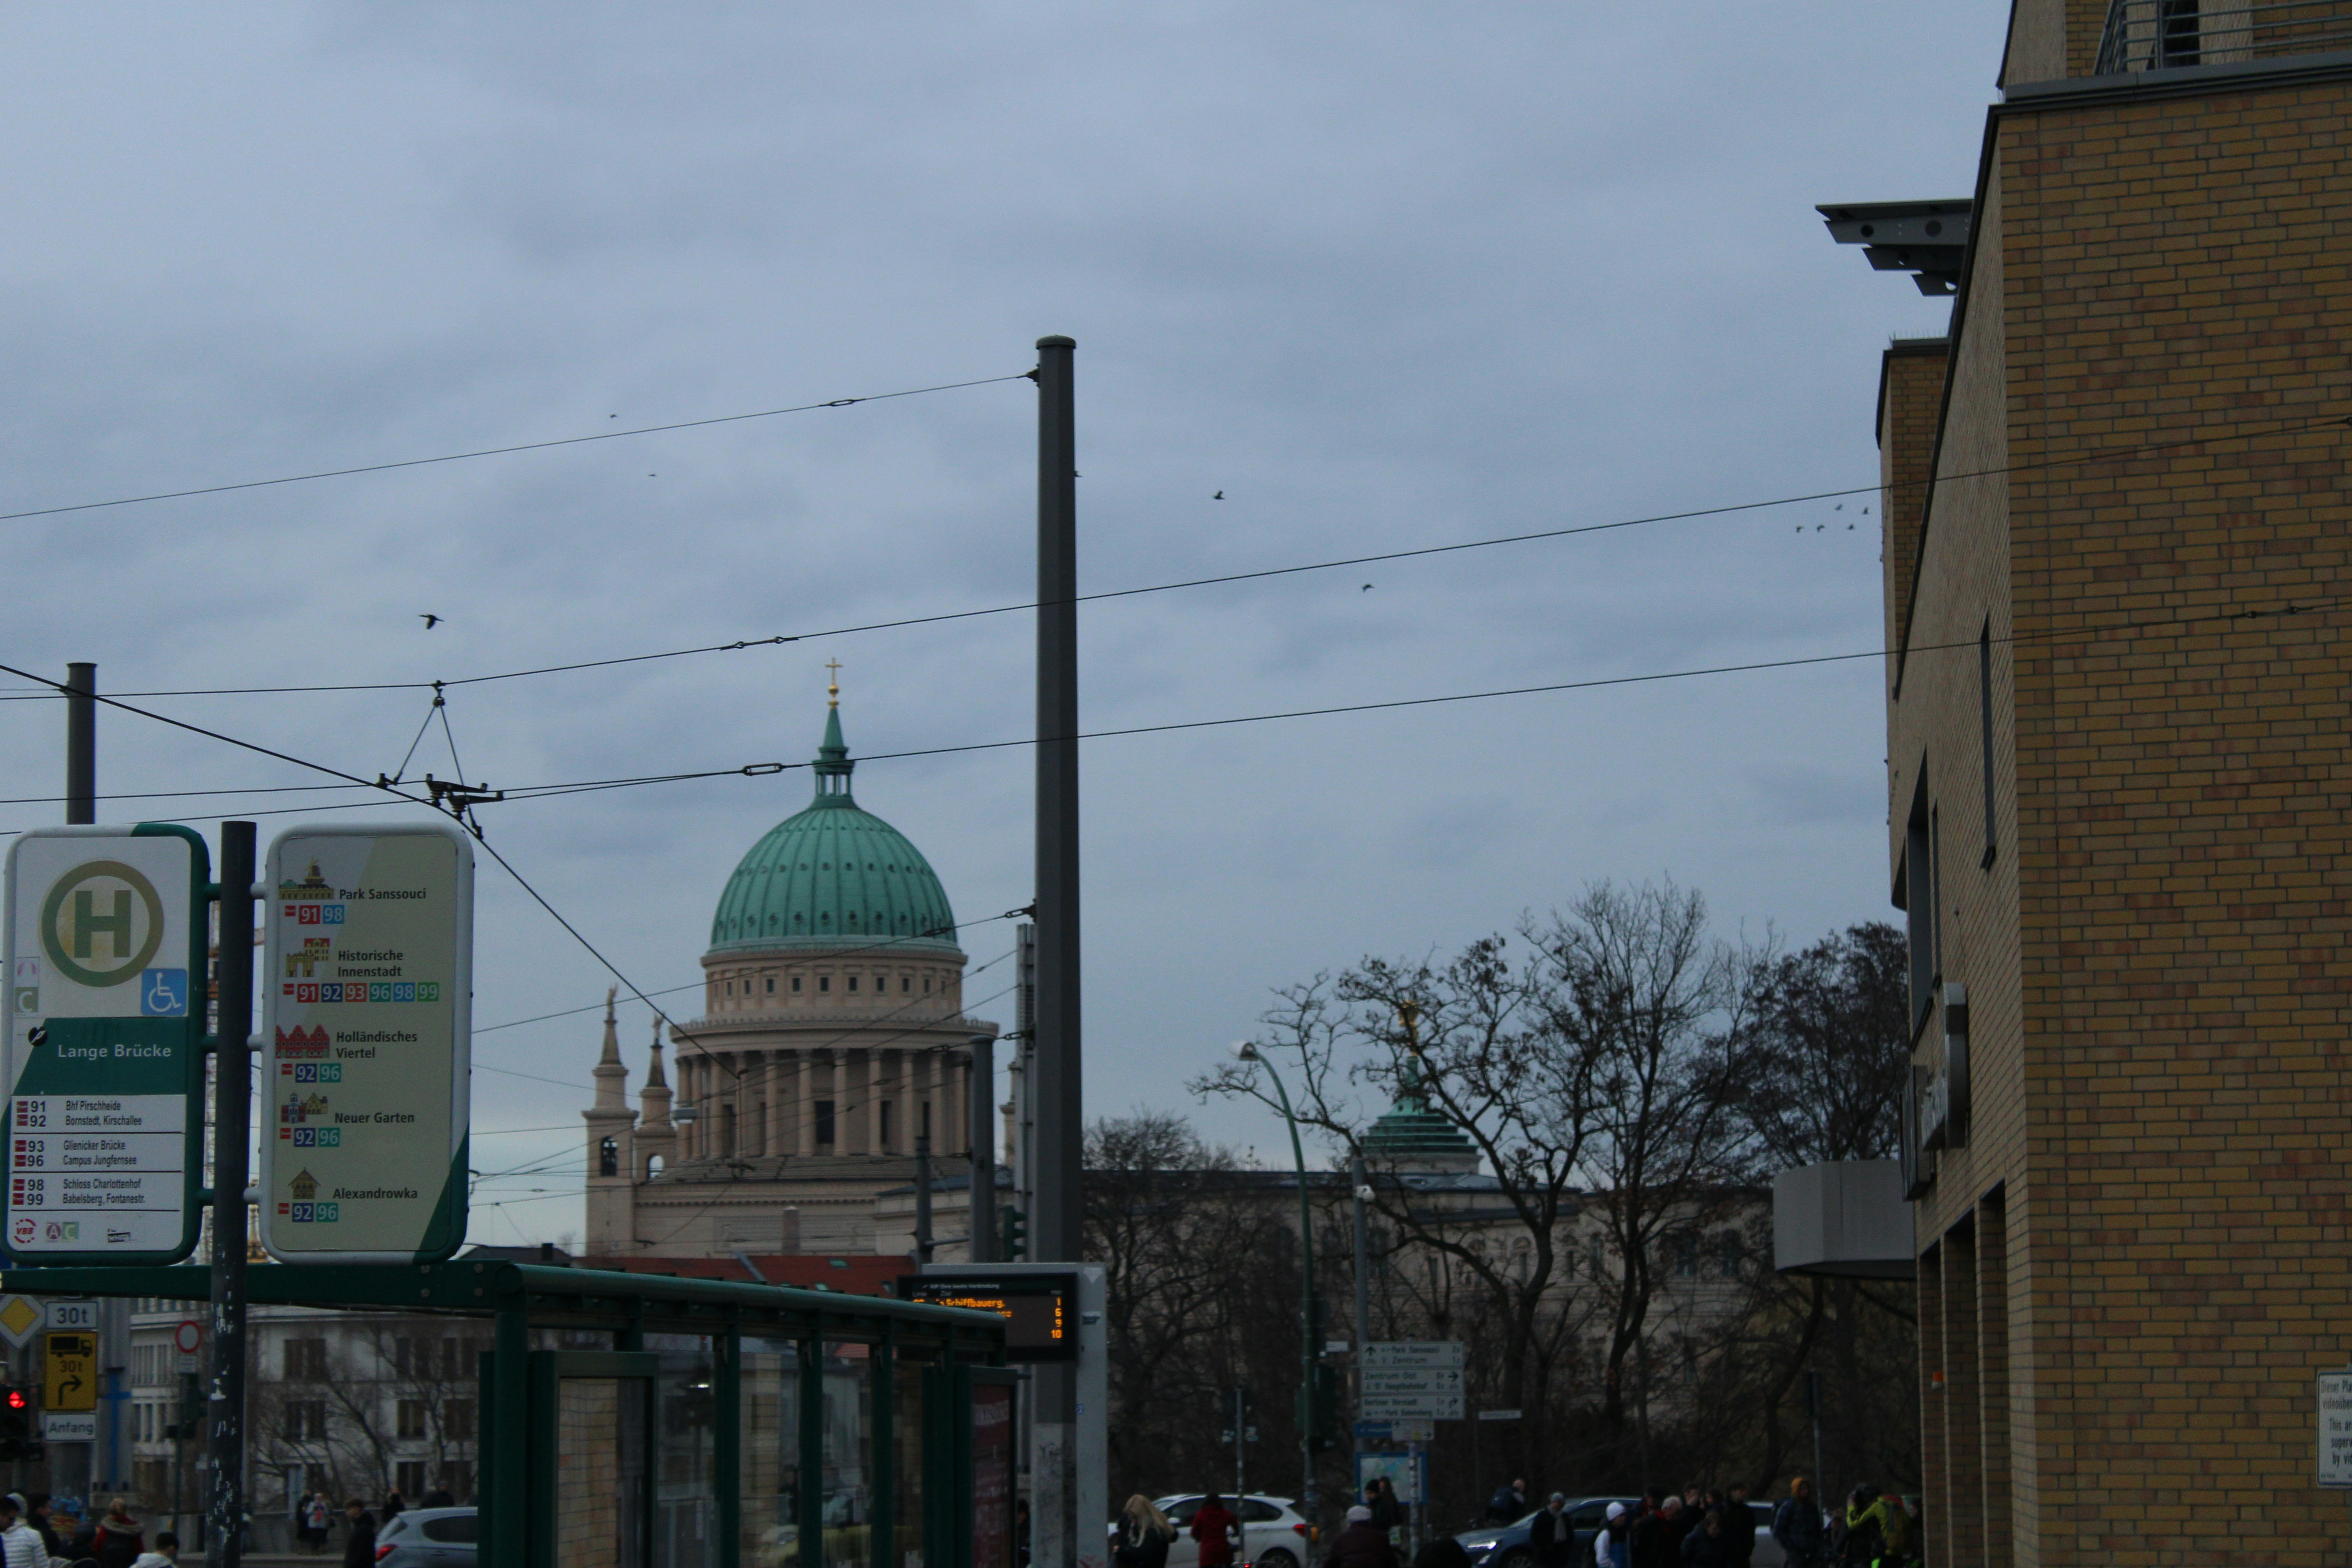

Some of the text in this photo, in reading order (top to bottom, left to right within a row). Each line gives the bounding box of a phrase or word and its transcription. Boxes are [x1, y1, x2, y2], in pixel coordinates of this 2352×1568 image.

[339, 888, 426, 899] Park Sanssouci
[301, 907, 318, 922] 91
[324, 907, 343, 922] 98
[74, 890, 131, 958] H
[338, 950, 403, 961] Historische
[338, 966, 401, 977] Innenstadt
[300, 986, 317, 1001] 91
[323, 985, 341, 1000] 92
[347, 985, 365, 1000] 93
[371, 985, 390, 1000] 96
[395, 985, 414, 1000] 98
[419, 985, 437, 1000] 99
[337, 1031, 417, 1042] Holländisches
[58, 1043, 171, 1060] Lange Brücke
[336, 1047, 376, 1058] Viertel
[297, 1066, 315, 1080] 92
[321, 1066, 339, 1080] 96
[31, 1102, 45, 1112] 91
[66, 1101, 78, 1110] Bhf
[80, 1100, 121, 1111] Pirschheide
[30, 1116, 46, 1127] 92
[65, 1116, 101, 1127] Bornstedt,
[103, 1115, 142, 1125] Kirschallee
[335, 1112, 414, 1123] Neuer Garten
[296, 1131, 313, 1145] 92
[319, 1130, 338, 1144] 96
[29, 1141, 44, 1152] 93
[64, 1140, 98, 1150] Glienicker
[101, 1140, 125, 1150] Brücke
[27, 1156, 44, 1167] 96
[63, 1155, 91, 1167] Campus
[93, 1154, 136, 1167] Jungfernsee
[28, 1180, 44, 1190] 98
[63, 1179, 91, 1189] Schloss
[93, 1178, 141, 1189] Charlottenhof
[27, 1194, 43, 1205] 99
[107, 1193, 145, 1203] Fontanestr.
[332, 1188, 417, 1199] Alexandrowka
[294, 1206, 312, 1220] 92
[318, 1205, 336, 1220] 96
[1056, 1298, 1062, 1306] 1
[57, 1308, 88, 1323] 30 t
[1055, 1308, 1062, 1317] 6
[1055, 1319, 1062, 1328] 9
[1051, 1329, 1063, 1339] 10
[60, 1360, 83, 1372] 30 t
[49, 1421, 94, 1434] Anfang
[2329, 1419, 2342, 1432] This
[2332, 1452, 2340, 1468] by
